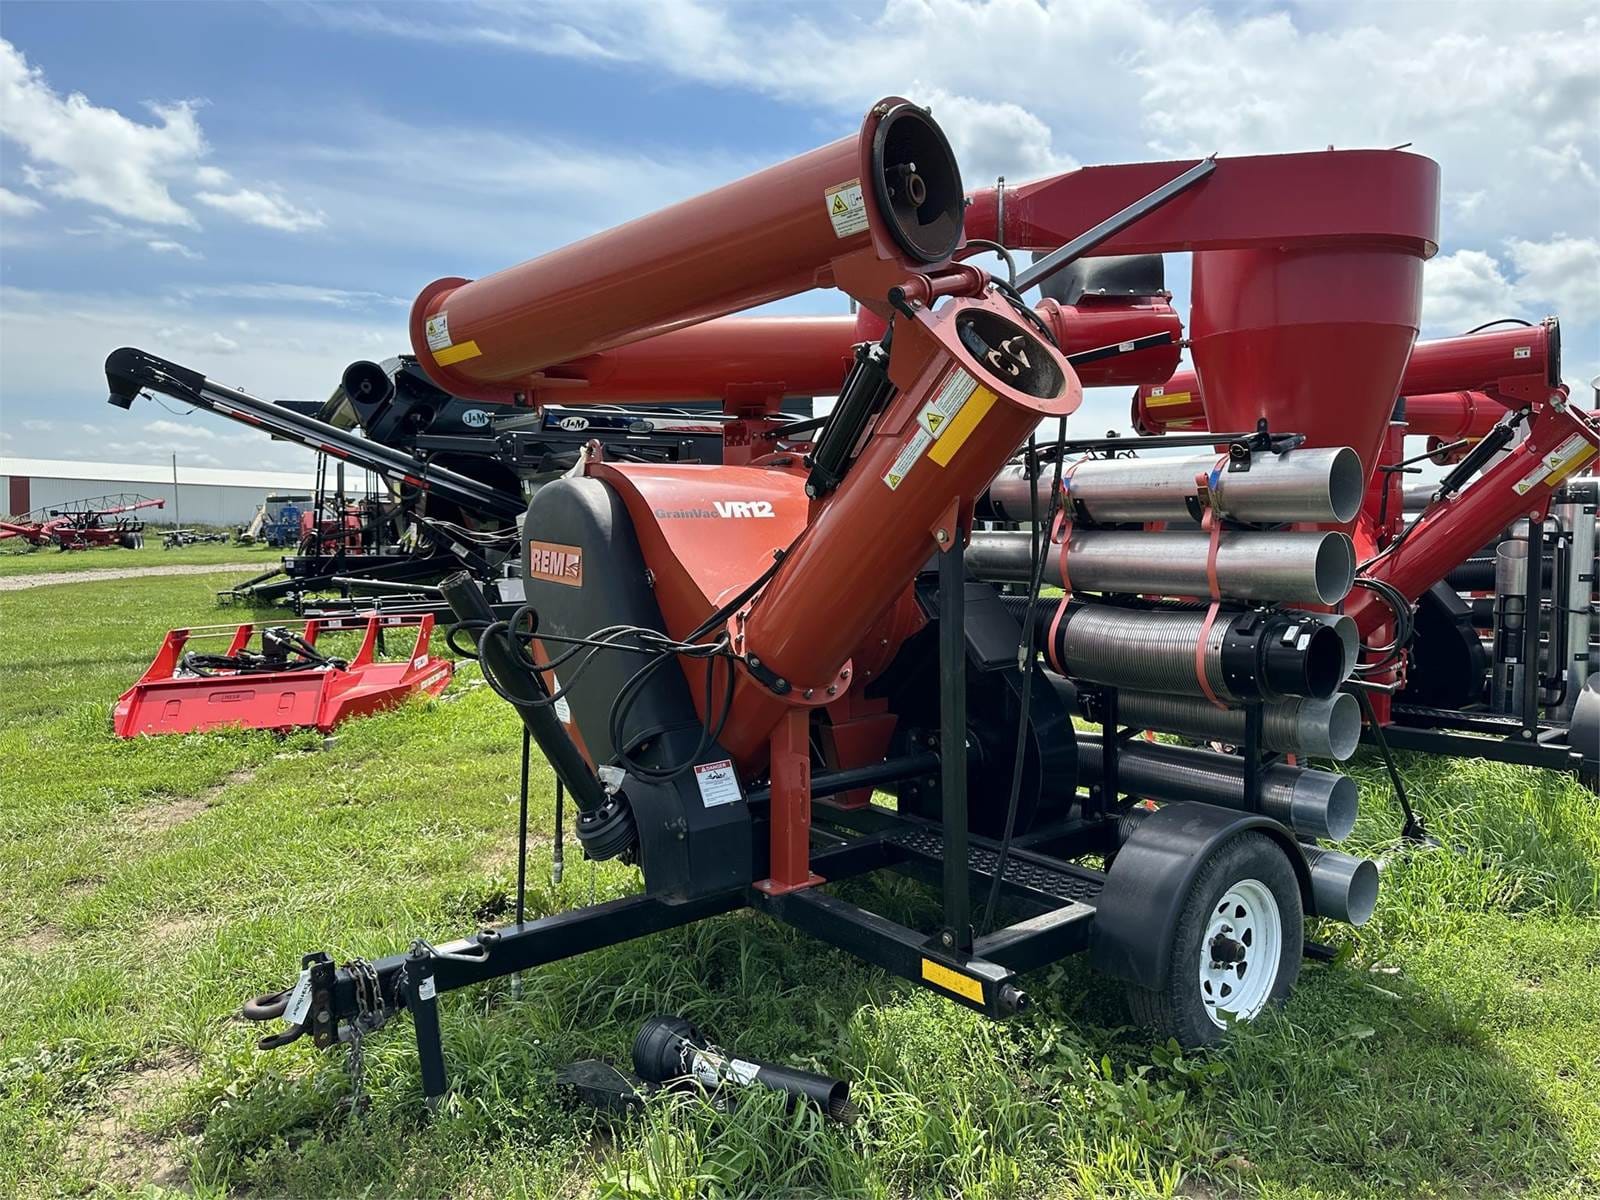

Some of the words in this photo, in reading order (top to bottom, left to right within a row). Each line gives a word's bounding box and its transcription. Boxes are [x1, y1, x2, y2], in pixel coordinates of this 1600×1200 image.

[466, 412, 486, 424] J&M
[564, 419, 586, 429] J&M
[655, 508, 719, 519] GrainVac
[713, 501, 776, 518] VR12
[531, 549, 566, 577] REM
